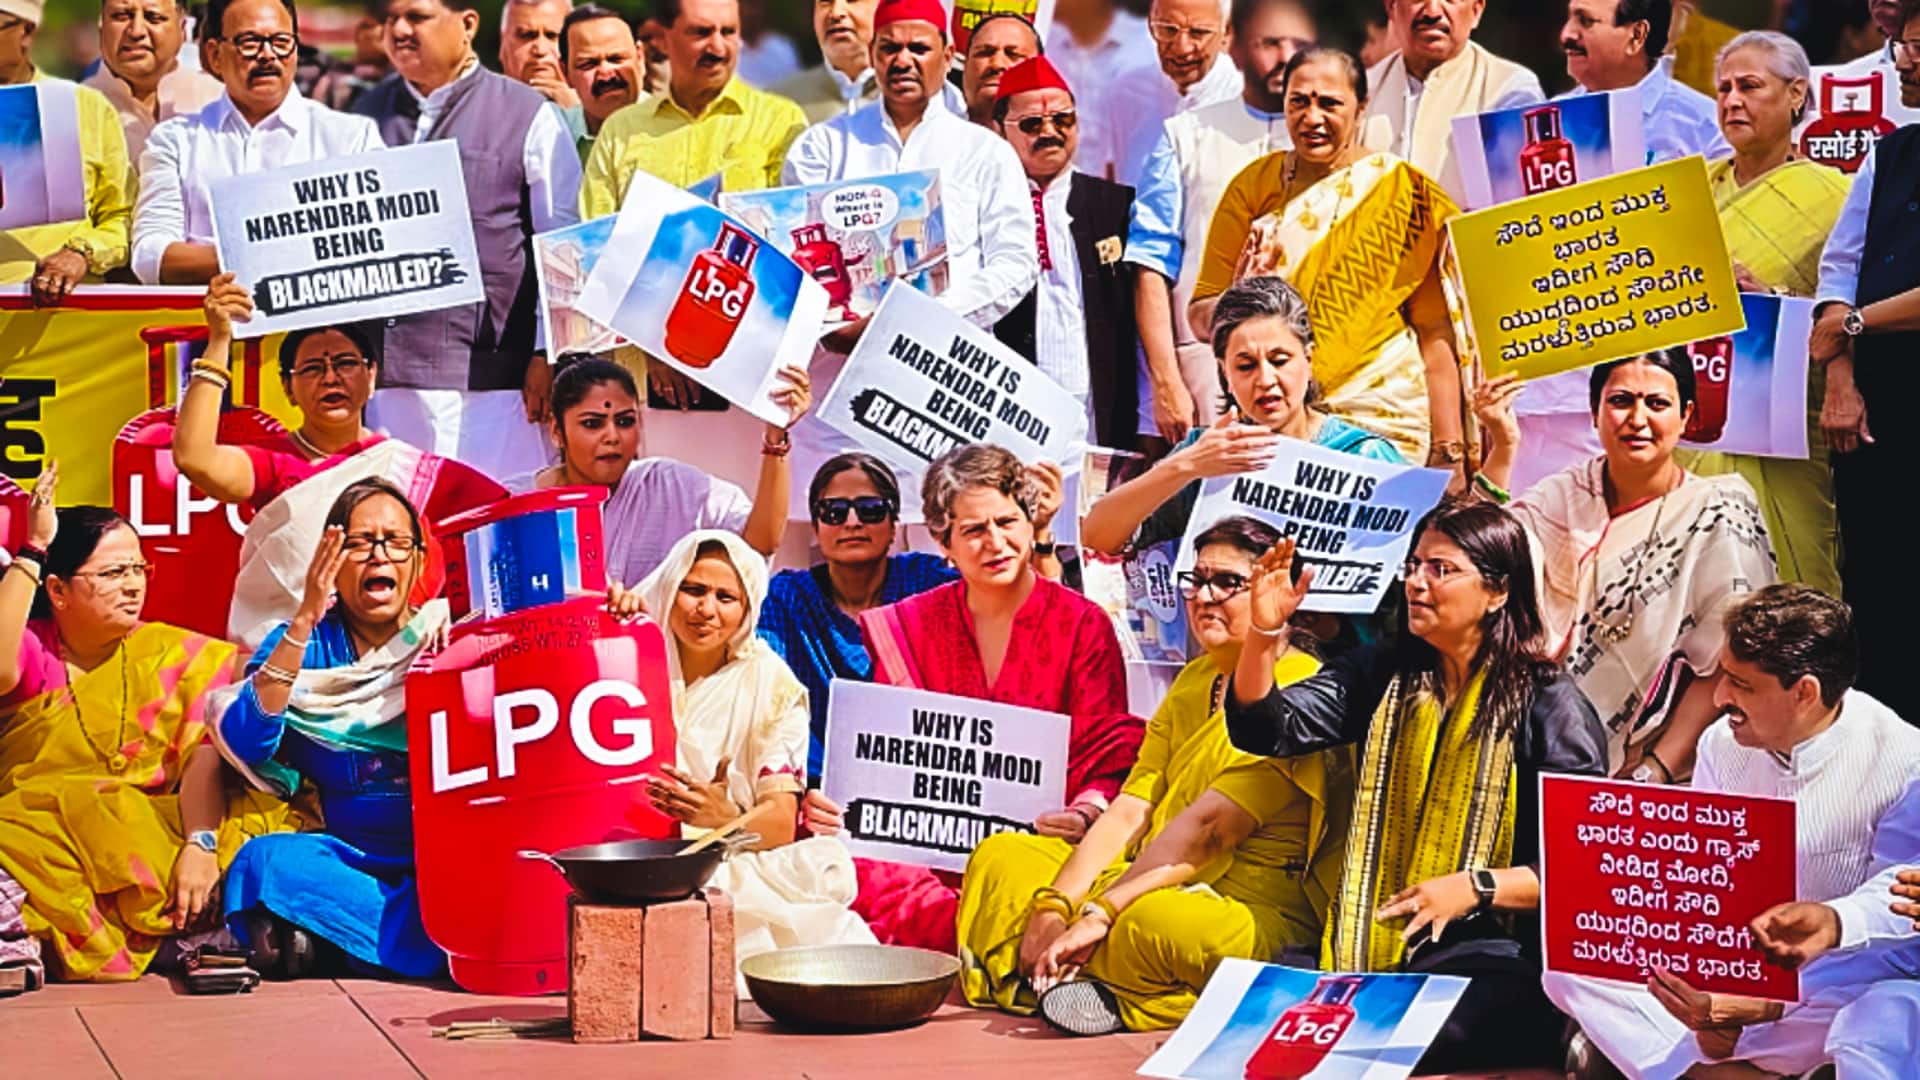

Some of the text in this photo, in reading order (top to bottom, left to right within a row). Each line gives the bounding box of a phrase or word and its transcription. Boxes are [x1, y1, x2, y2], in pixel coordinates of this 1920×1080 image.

[1807, 129, 1858, 160] रसोई
[293, 169, 381, 205] WHY IS
[1526, 161, 1572, 191] LPG
[244, 189, 440, 242] NARENDRA MODI
[1550, 201, 1604, 230] ಇಂದ
[313, 227, 385, 261] BEING
[1554, 227, 1620, 262] ಭಾರತ
[268, 258, 443, 310] BLACKMAILED?
[689, 269, 744, 318] LPG
[1532, 261, 1597, 293] ಇದೀಗ
[1643, 291, 1718, 328] ಭಾರತ.
[949, 335, 1021, 395] WHY IS
[1693, 353, 1727, 382] PG
[889, 334, 1051, 446] NARENDRA MODI
[926, 388, 992, 440] BEING
[1294, 460, 1377, 501] WHY IS
[130, 473, 256, 537] LP
[1232, 477, 1410, 533] NARENDRA MODI
[430, 679, 653, 794] LPG
[912, 709, 993, 746] WHY IS
[855, 733, 1042, 786] NARENDRA MODI
[913, 772, 982, 807] BEING
[1639, 801, 1689, 822] ಇಂದ
[1695, 804, 1748, 837] ಮುಕ್ತ
[1577, 824, 1635, 847] ಭಾರತ
[1640, 831, 1699, 854] ಎಂದು
[1611, 884, 1721, 916] ಇದೀಗ ಸೌದಿ
[1697, 957, 1769, 982] ಭಾರತ.
[1274, 1021, 1340, 1045] LPG
